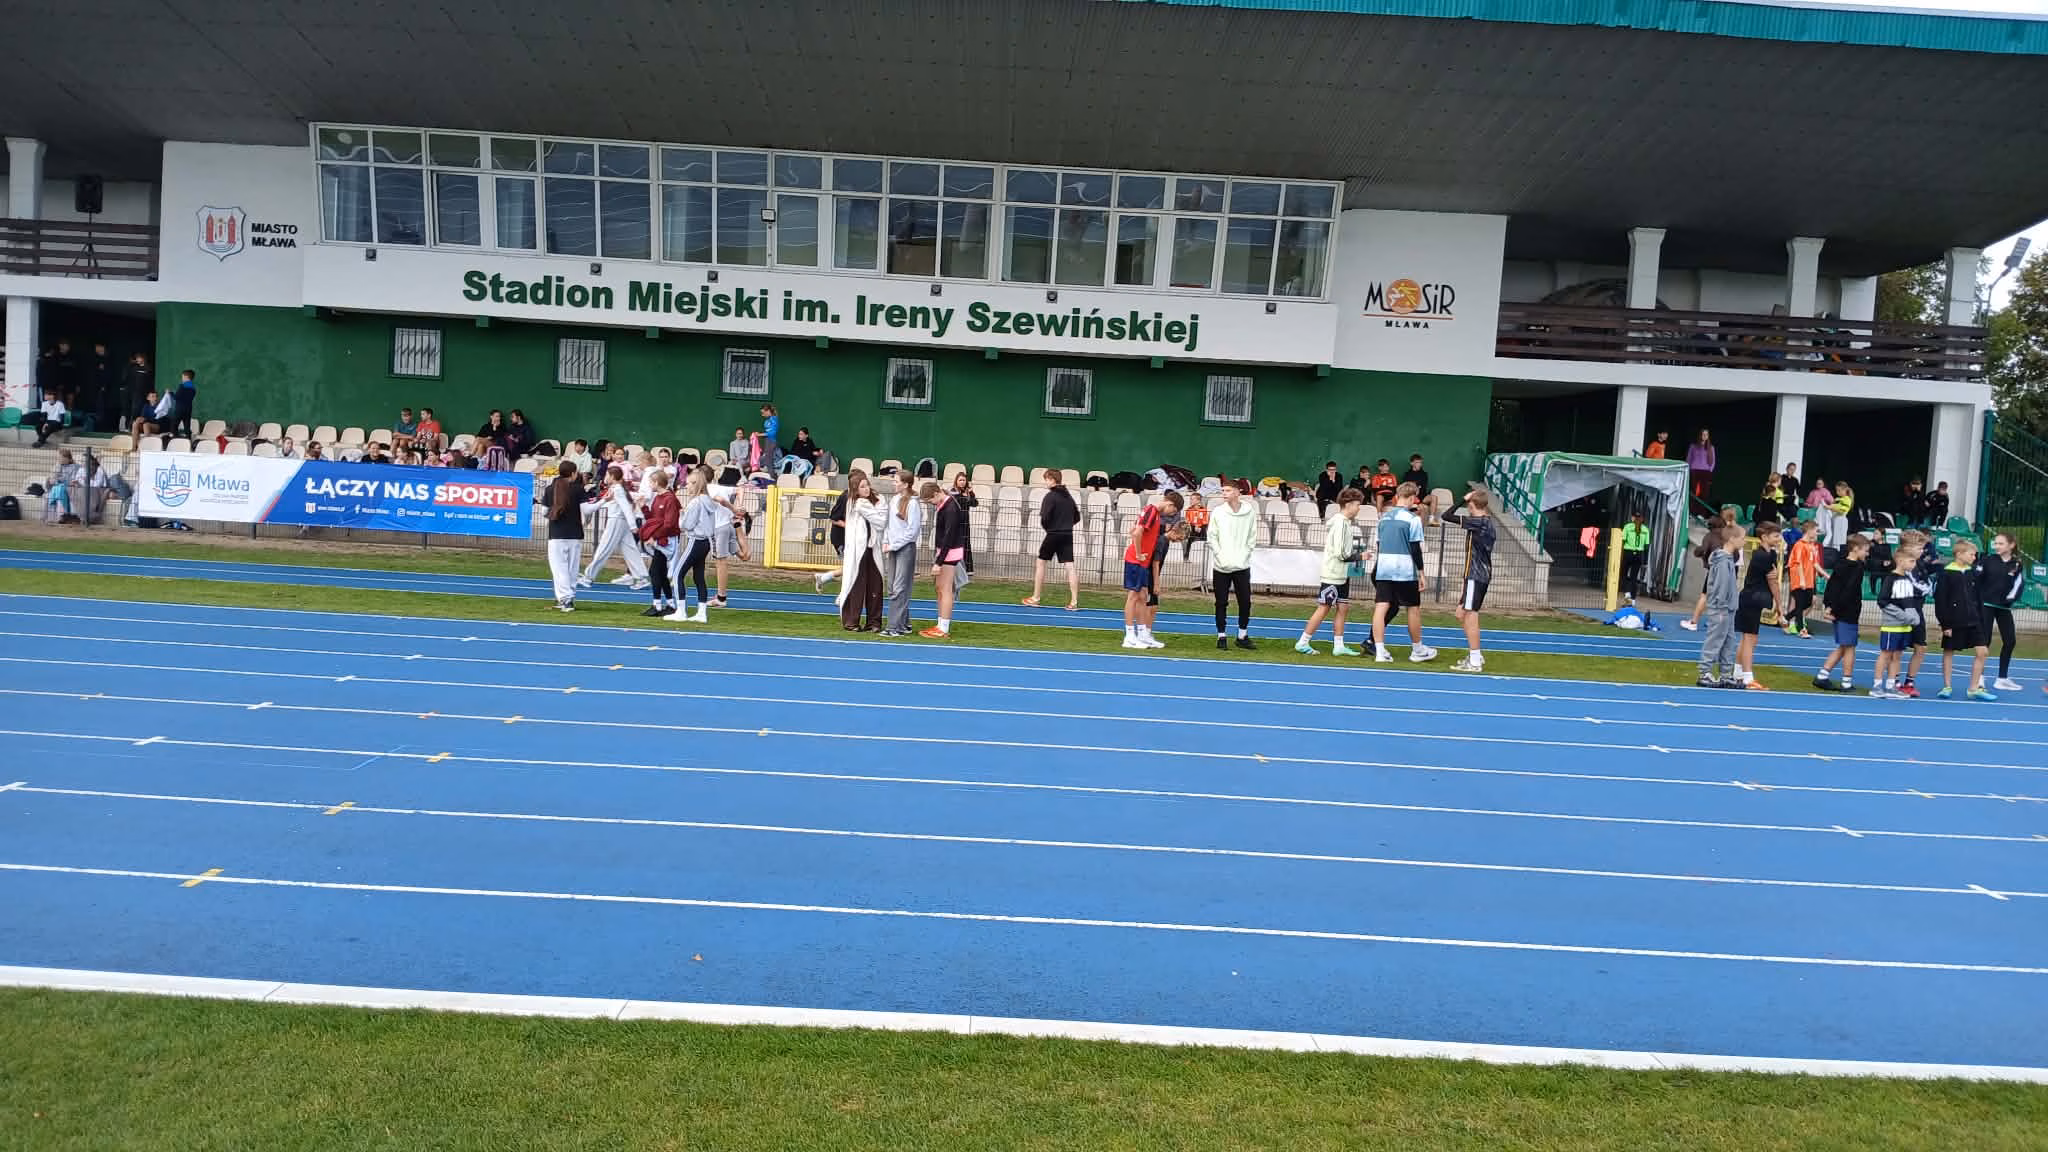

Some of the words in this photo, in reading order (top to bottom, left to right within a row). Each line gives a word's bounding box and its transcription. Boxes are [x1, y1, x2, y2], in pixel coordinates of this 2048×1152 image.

[251, 223, 298, 235] MIASTO
[251, 237, 297, 248] MŁAWA
[462, 270, 614, 310] Stadion
[628, 281, 768, 323] Miejski
[783, 290, 841, 324] im.
[856, 295, 954, 338] Ireny
[966, 301, 1201, 352] Szewińskiej
[196, 473, 250, 491] Mława
[305, 477, 379, 499] ŁĄCZY
[384, 482, 430, 501] NAS
[434, 484, 513, 506] SPORT!
